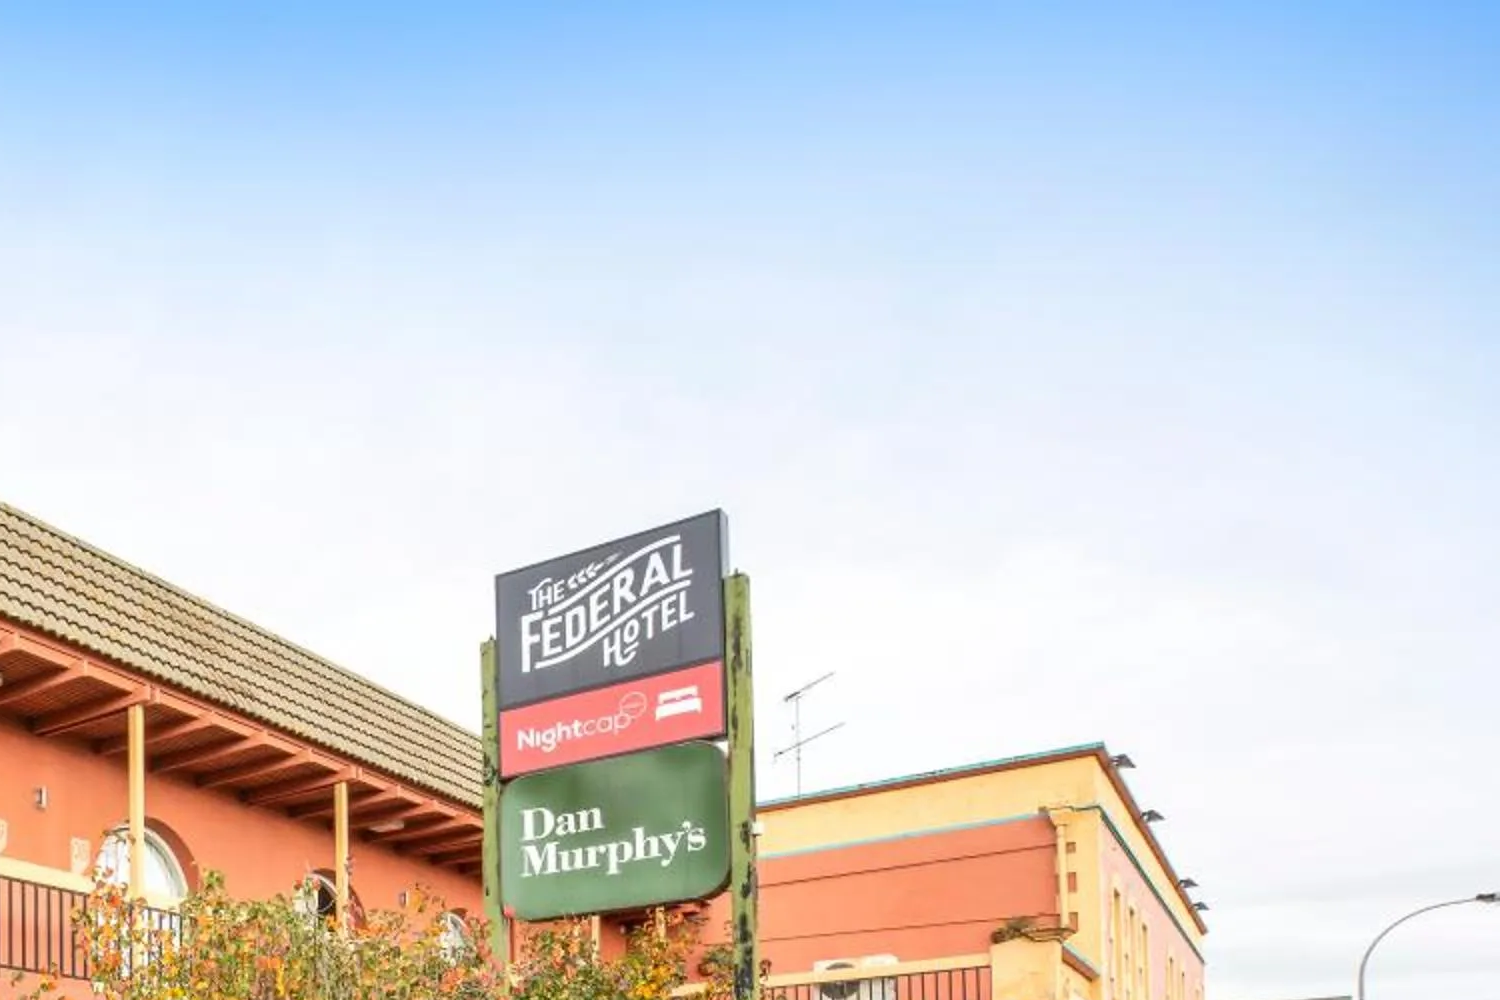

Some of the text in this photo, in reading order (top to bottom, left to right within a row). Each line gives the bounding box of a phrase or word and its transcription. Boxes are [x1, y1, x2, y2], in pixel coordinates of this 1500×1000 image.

[520, 544, 694, 673] FEDERAL
[527, 577, 565, 611] THE
[603, 590, 695, 667] HOTEL
[517, 712, 632, 753] Nightcap
[520, 806, 606, 842] Dan
[520, 820, 708, 877] Murphy's
